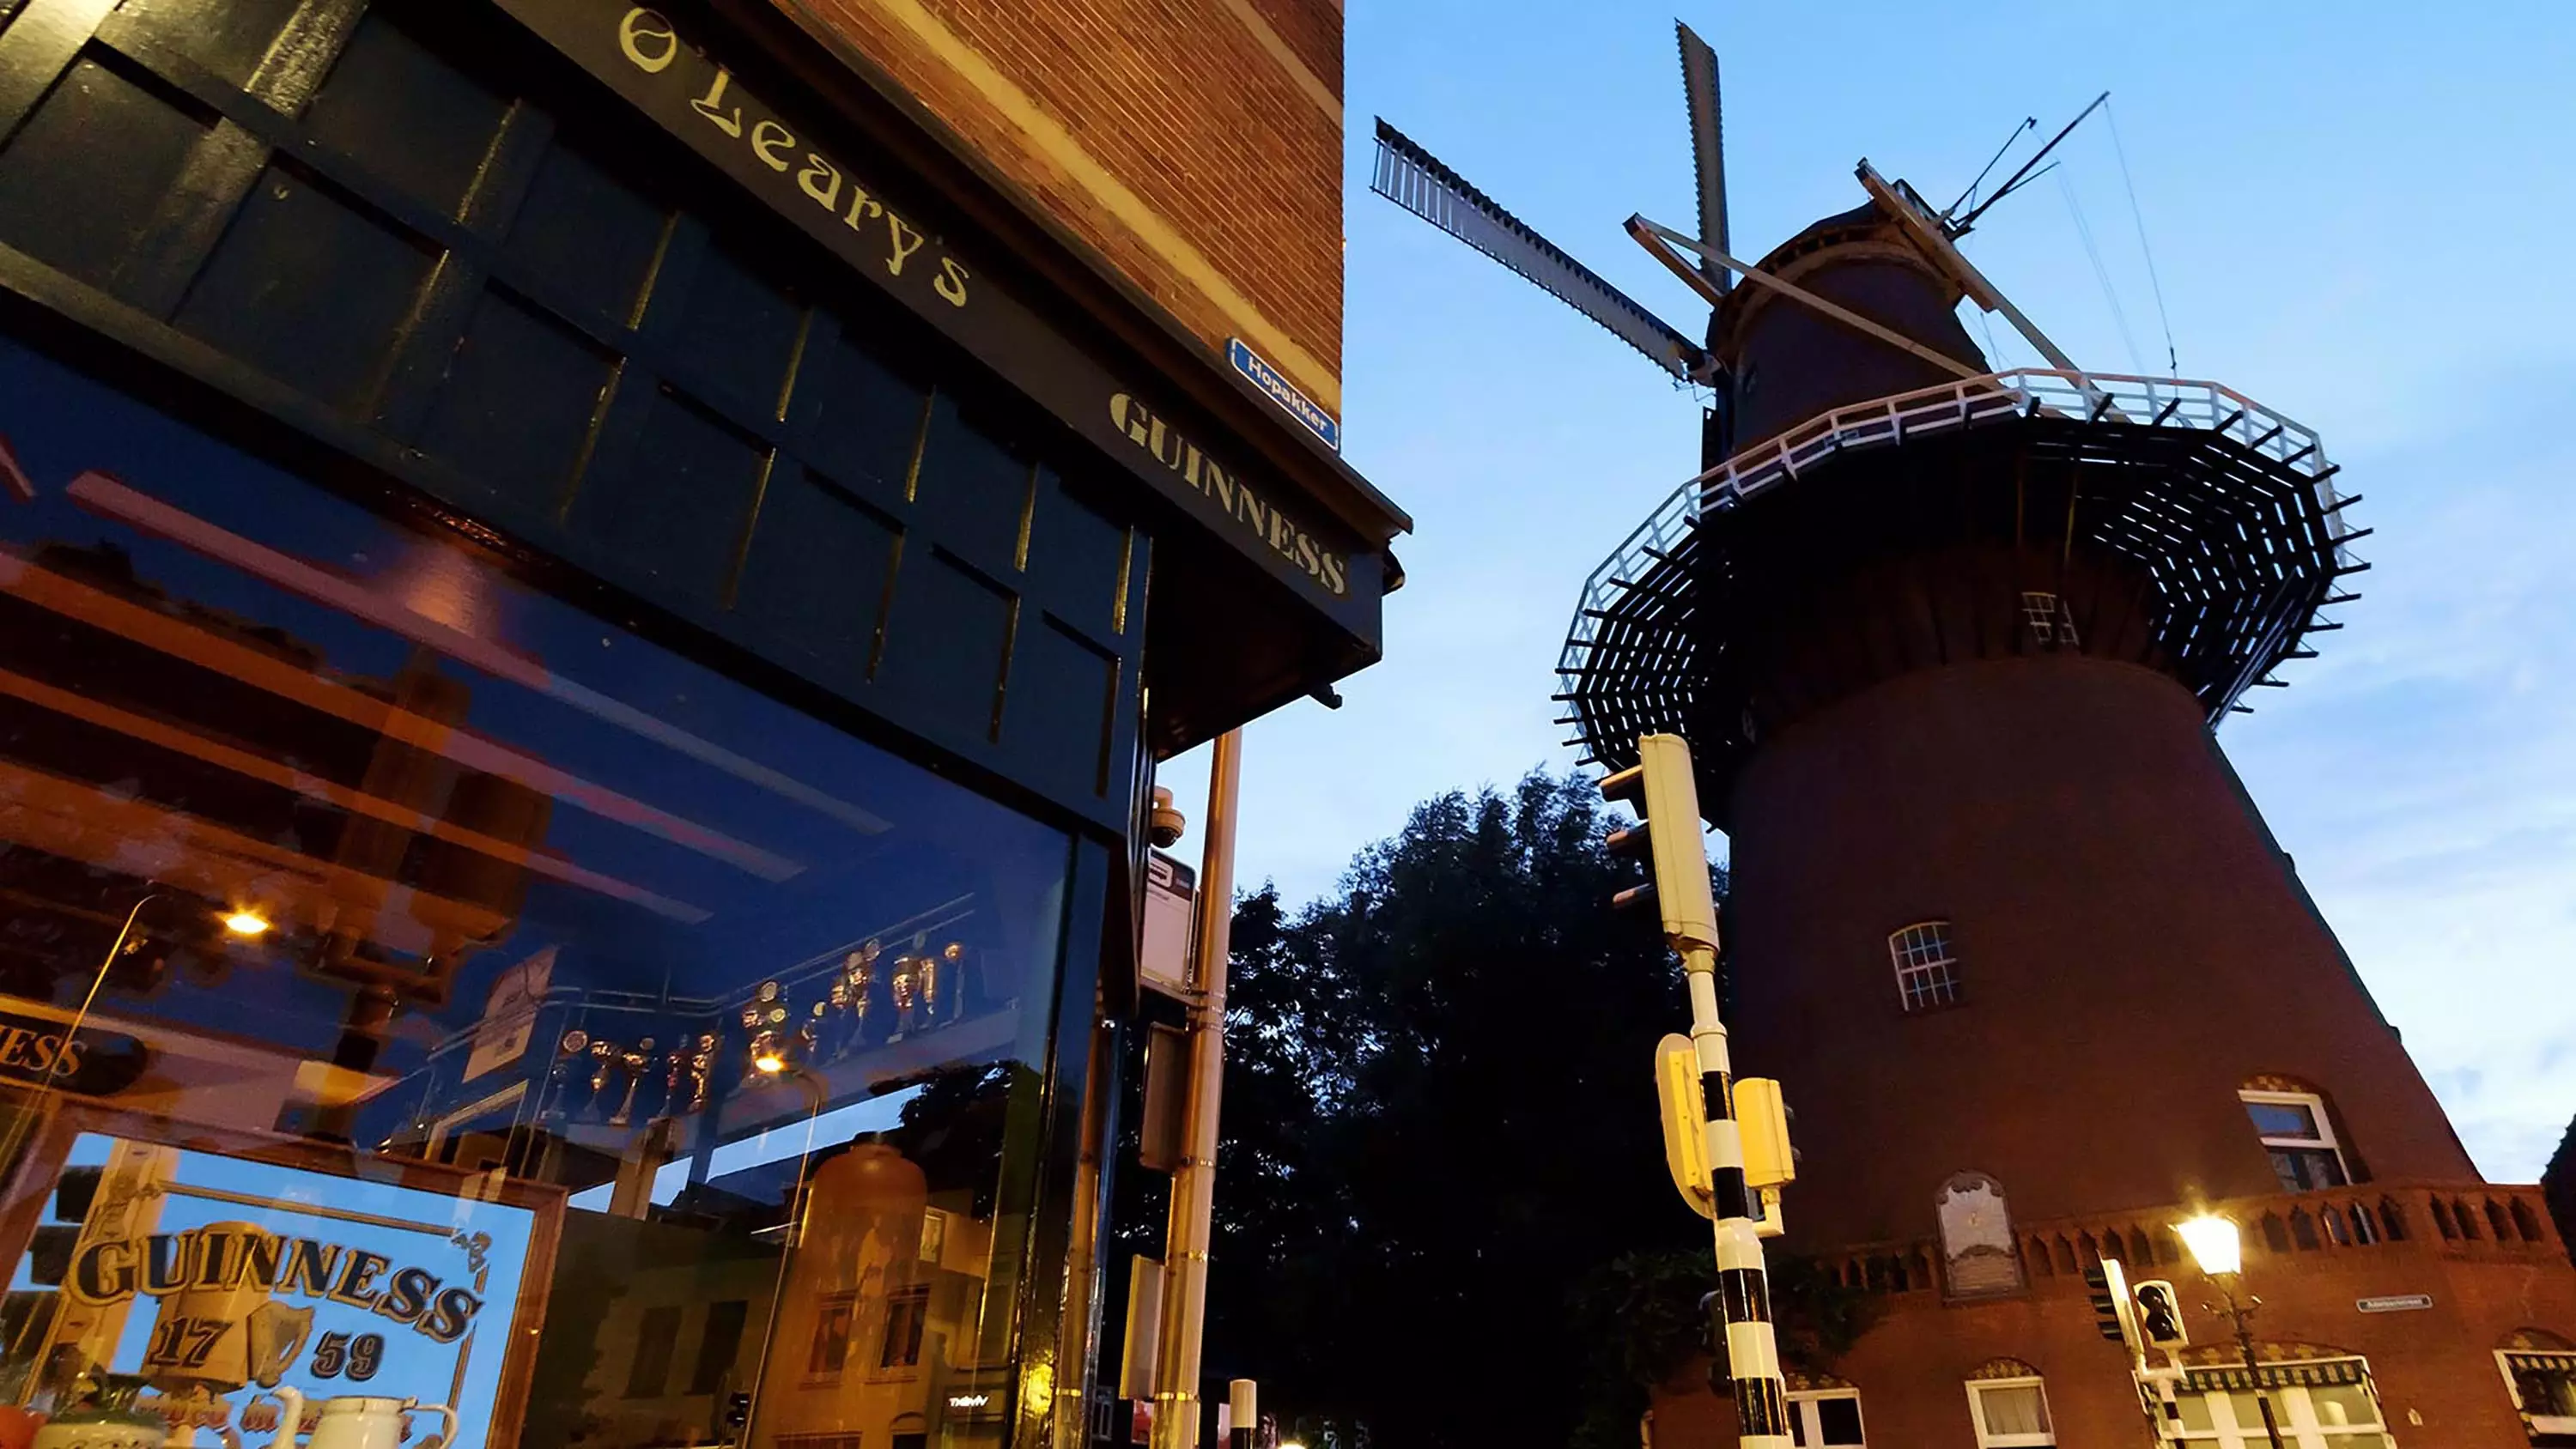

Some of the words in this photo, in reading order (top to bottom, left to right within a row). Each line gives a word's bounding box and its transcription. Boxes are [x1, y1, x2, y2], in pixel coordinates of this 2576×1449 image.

[1248, 355, 1328, 432] Hopakker
[1109, 392, 1345, 595] GUINNESS
[0, 1024, 88, 1076] ESS
[69, 1229, 484, 1344] GUINNESS
[149, 1317, 233, 1368] 17
[311, 1330, 386, 1383] 59
